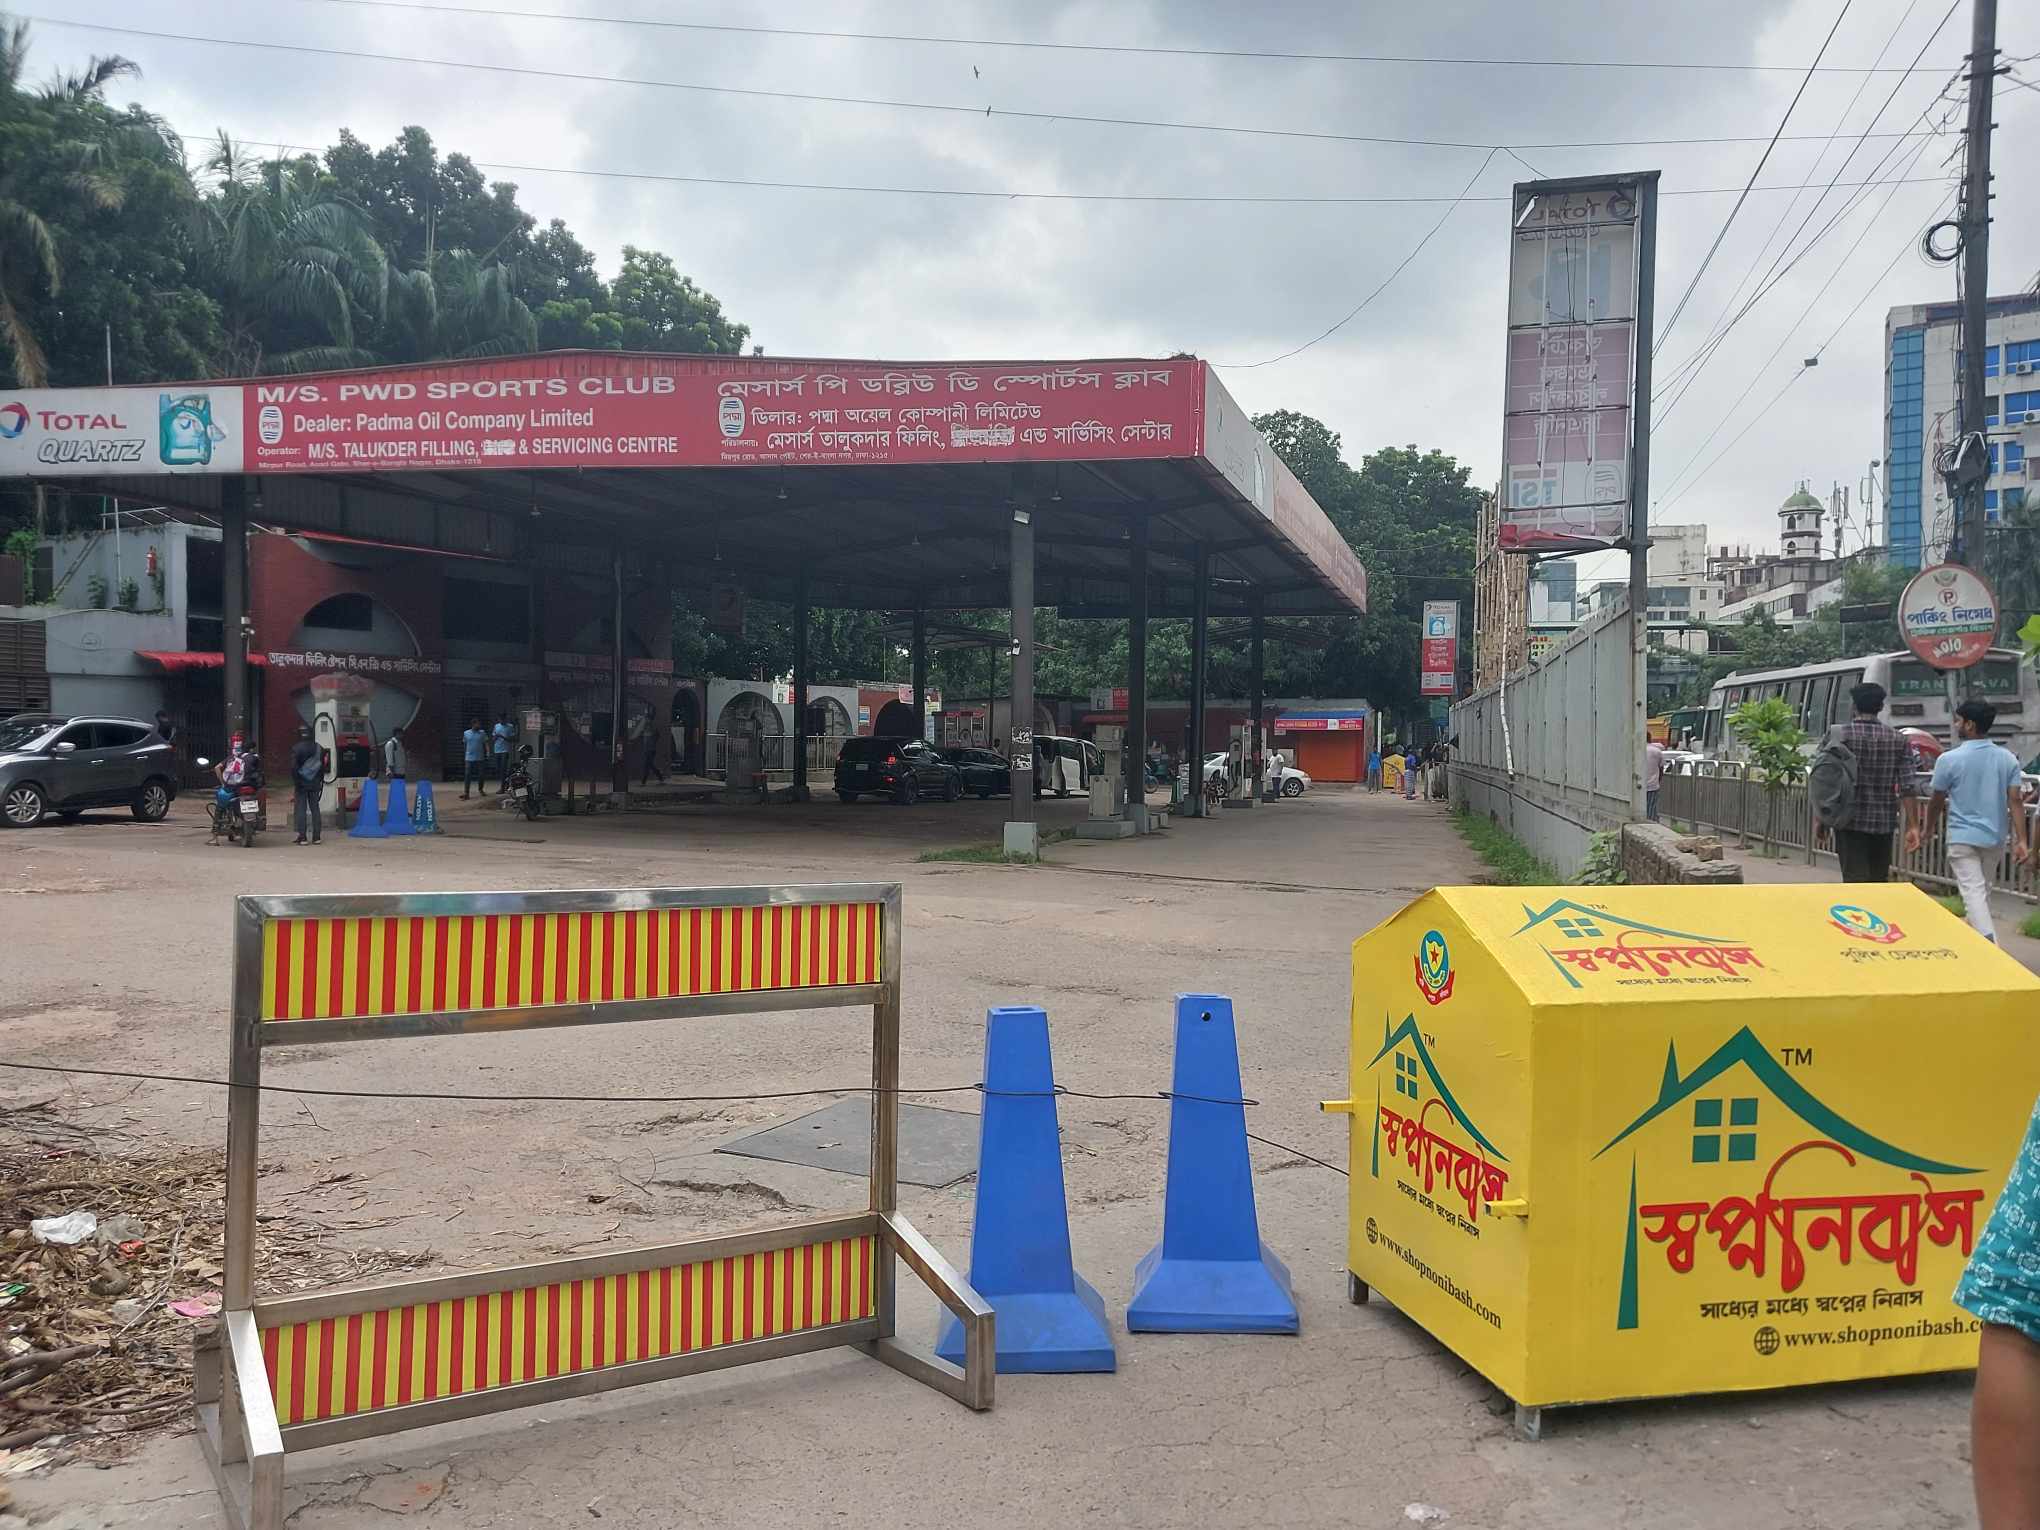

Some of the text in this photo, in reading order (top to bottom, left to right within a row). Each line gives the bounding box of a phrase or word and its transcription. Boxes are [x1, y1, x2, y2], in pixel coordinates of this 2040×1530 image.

[257, 376, 676, 403] M/S. PWD SPORTS CLUB
[718, 368, 1173, 397] মেসার্স পি ডব্লিউ ডি স্পোর্টস ক্লাব
[37, 410, 127, 430] TOTAL
[294, 413, 351, 432] Dealer:
[356, 411, 413, 430] Padma
[419, 410, 440, 429] Oil
[445, 411, 525, 432] Company
[530, 408, 594, 427] Limited
[808, 408, 839, 425] পদ্মা
[844, 407, 892, 424] অয়েল
[898, 402, 970, 423] কোম্পানী
[975, 401, 1041, 422] লিমিটেড
[767, 426, 814, 448] মেসার্স
[819, 428, 892, 452] তালুকদার
[896, 424, 946, 449] ফিলিং,
[1052, 420, 1116, 445] সার্ভিসিং
[1120, 418, 1173, 442] সেন্টার
[37, 438, 146, 465] QUARTZ
[257, 446, 301, 457] Operator:
[308, 443, 338, 458] M/S.
[342, 441, 418, 458] TALUKDER
[421, 440, 479, 459] FILLING,
[519, 440, 528, 454] &
[533, 437, 613, 455] SERVICING
[617, 437, 678, 454] CENTRE
[1907, 607, 1948, 624] পার্কিং
[1423, 1033, 1435, 1048] TM
[1781, 1048, 1813, 1066] TM
[1379, 1232, 1502, 1330] www.shopnonibash.com
[1700, 1288, 1924, 1319] সাধ্যের মধ্যে স্বপ্নের নিবাস
